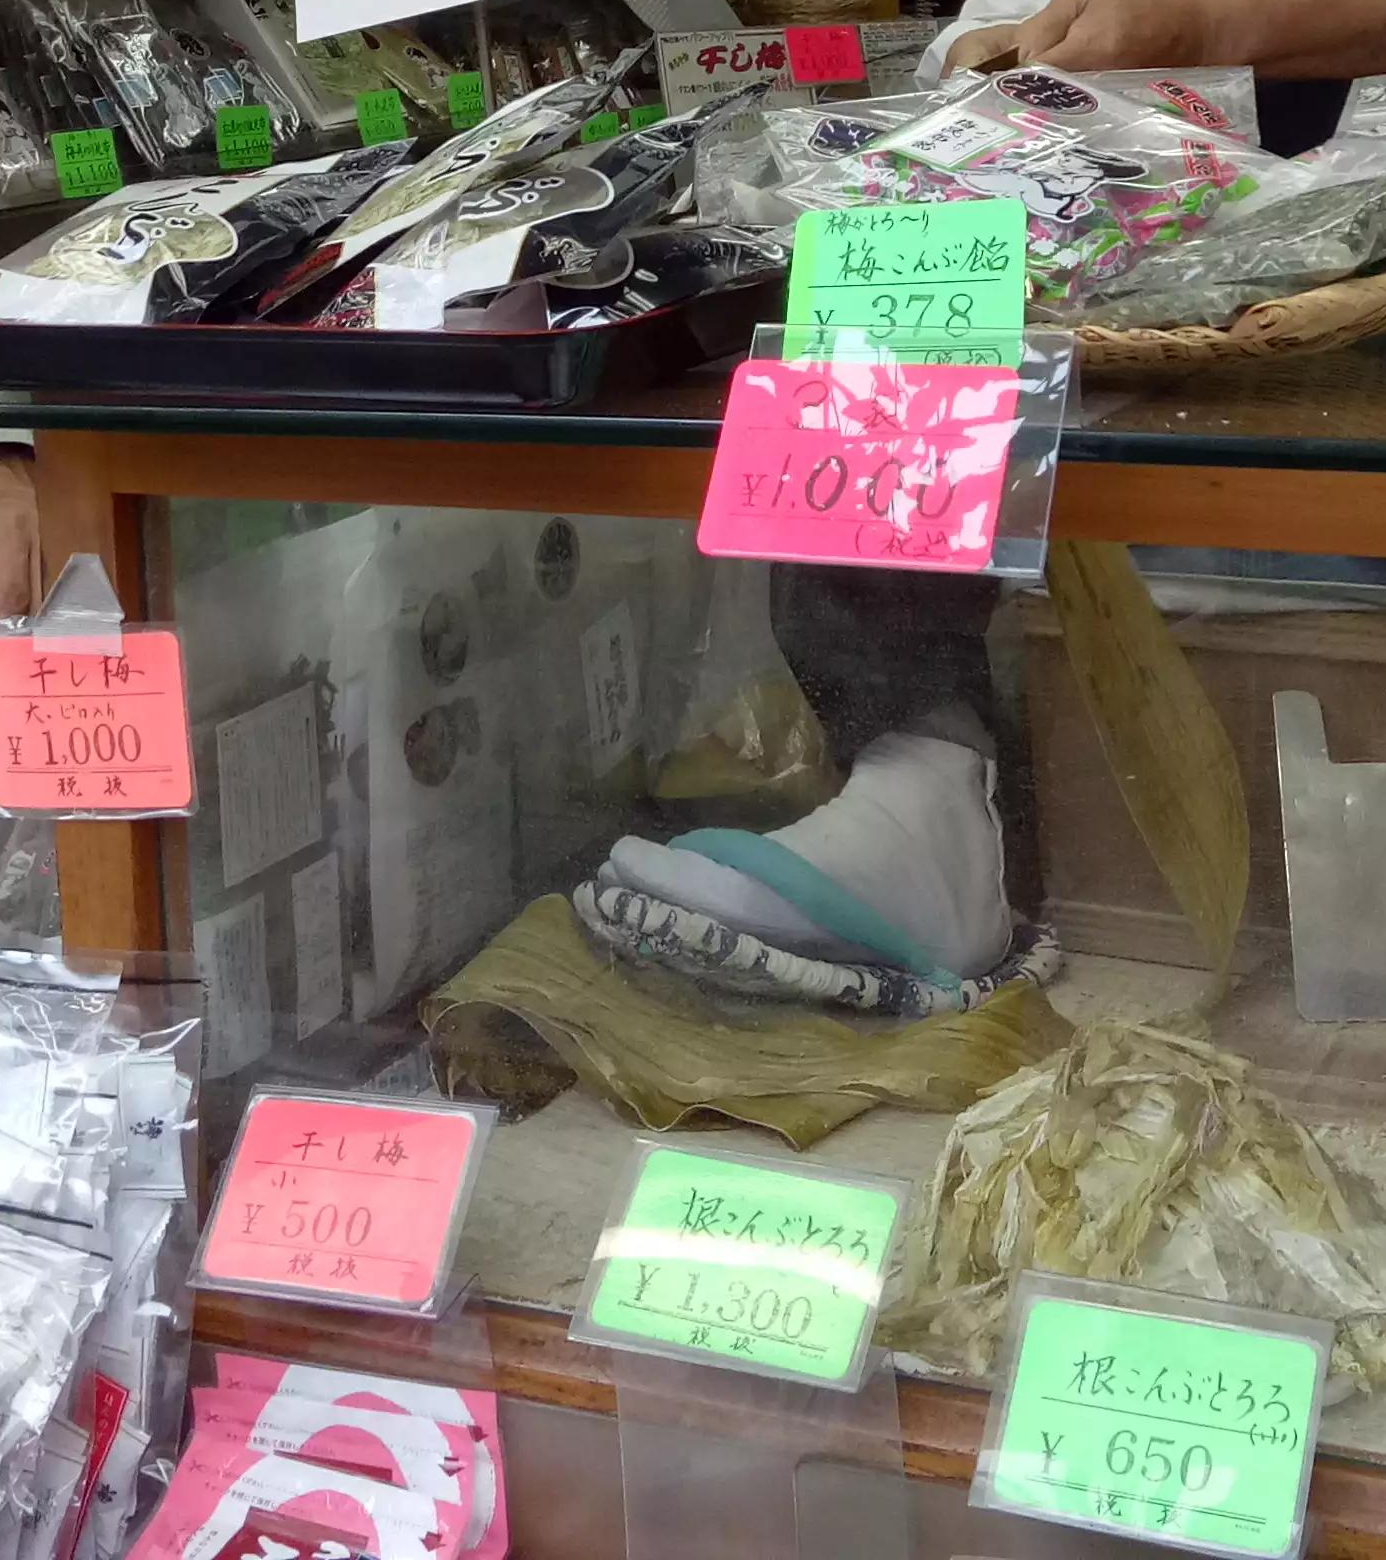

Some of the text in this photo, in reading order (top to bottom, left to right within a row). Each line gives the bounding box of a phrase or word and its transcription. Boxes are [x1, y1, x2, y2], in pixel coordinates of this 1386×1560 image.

[836, 235, 1011, 283] 梅こんぶ飴
[28, 654, 145, 695] 干し梅
[292, 1131, 410, 1167] 干し梅
[679, 1186, 870, 1268] 根こんぶとろろ
[1065, 1350, 1291, 1424] 根こんぶとろろ
